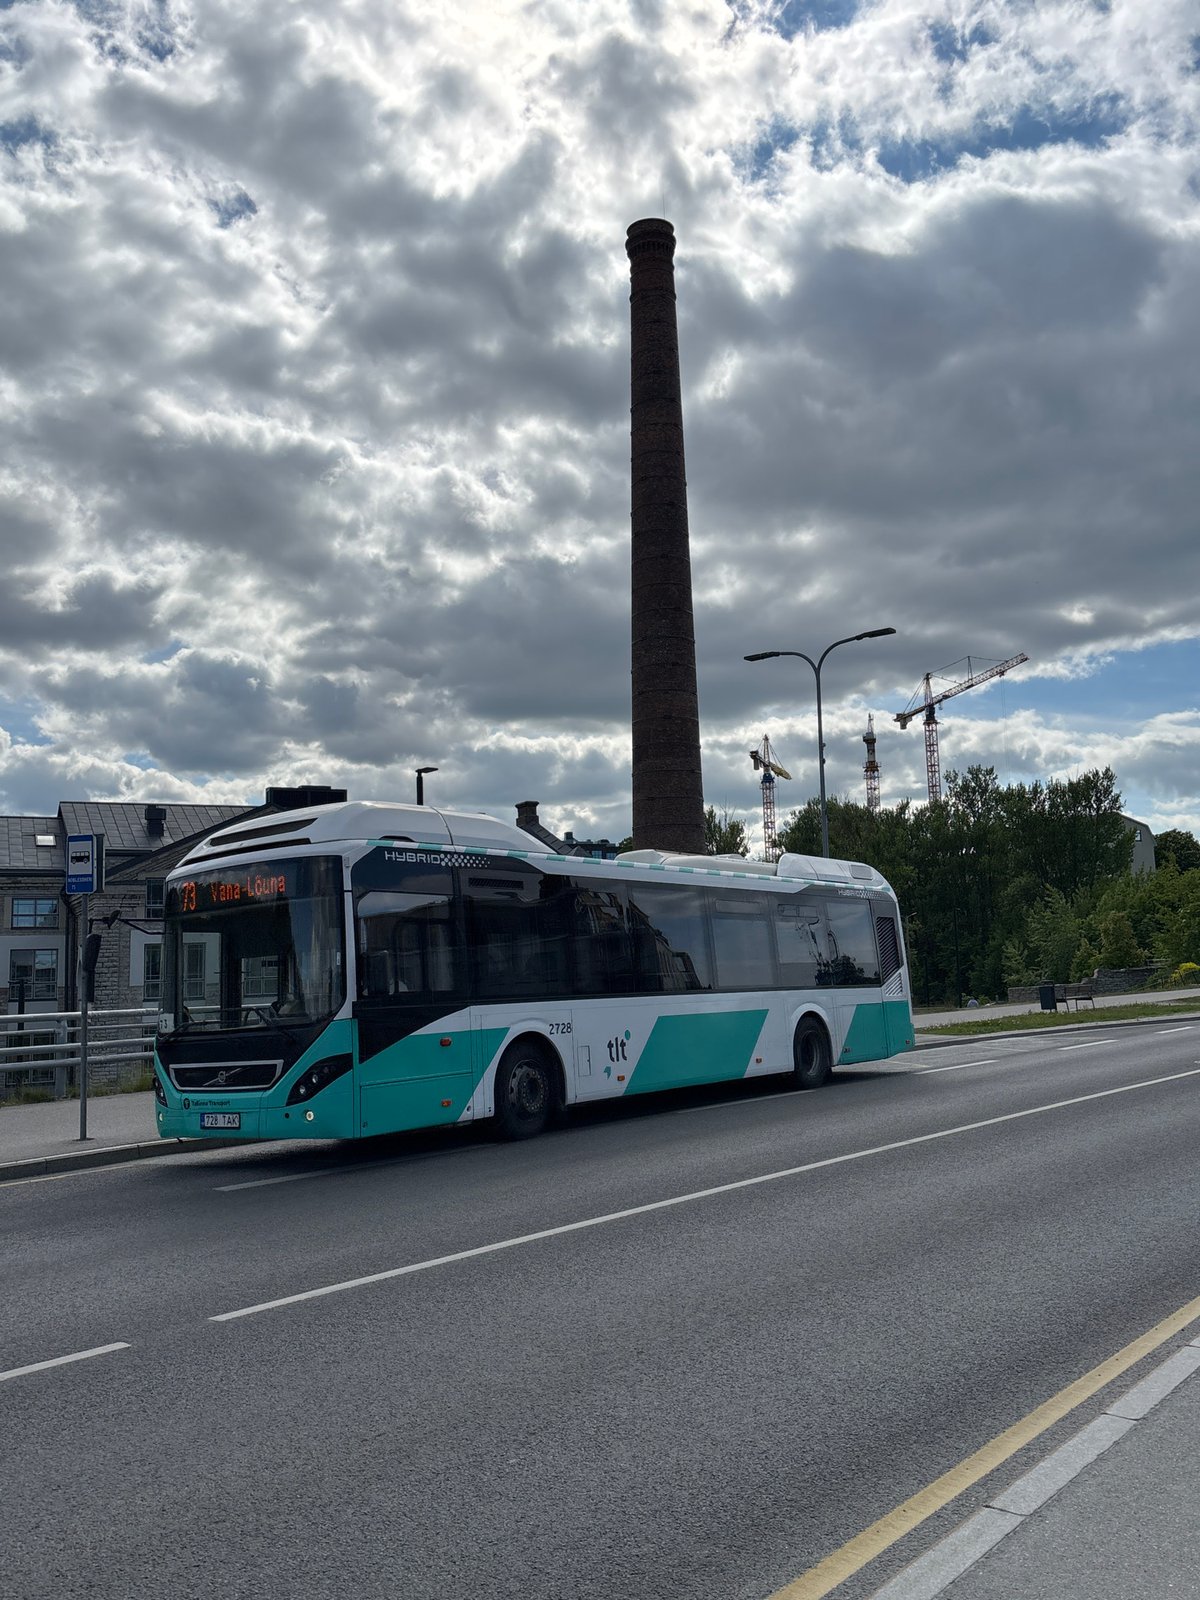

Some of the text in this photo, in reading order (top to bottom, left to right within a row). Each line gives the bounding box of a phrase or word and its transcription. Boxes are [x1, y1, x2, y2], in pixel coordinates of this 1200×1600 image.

[385, 850, 440, 865] HYBRID
[183, 875, 286, 911] 73 Vana-Lõuna
[549, 1022, 572, 1035] 2728
[607, 1036, 627, 1062] tlt
[206, 1115, 239, 1126] 728 TAK
